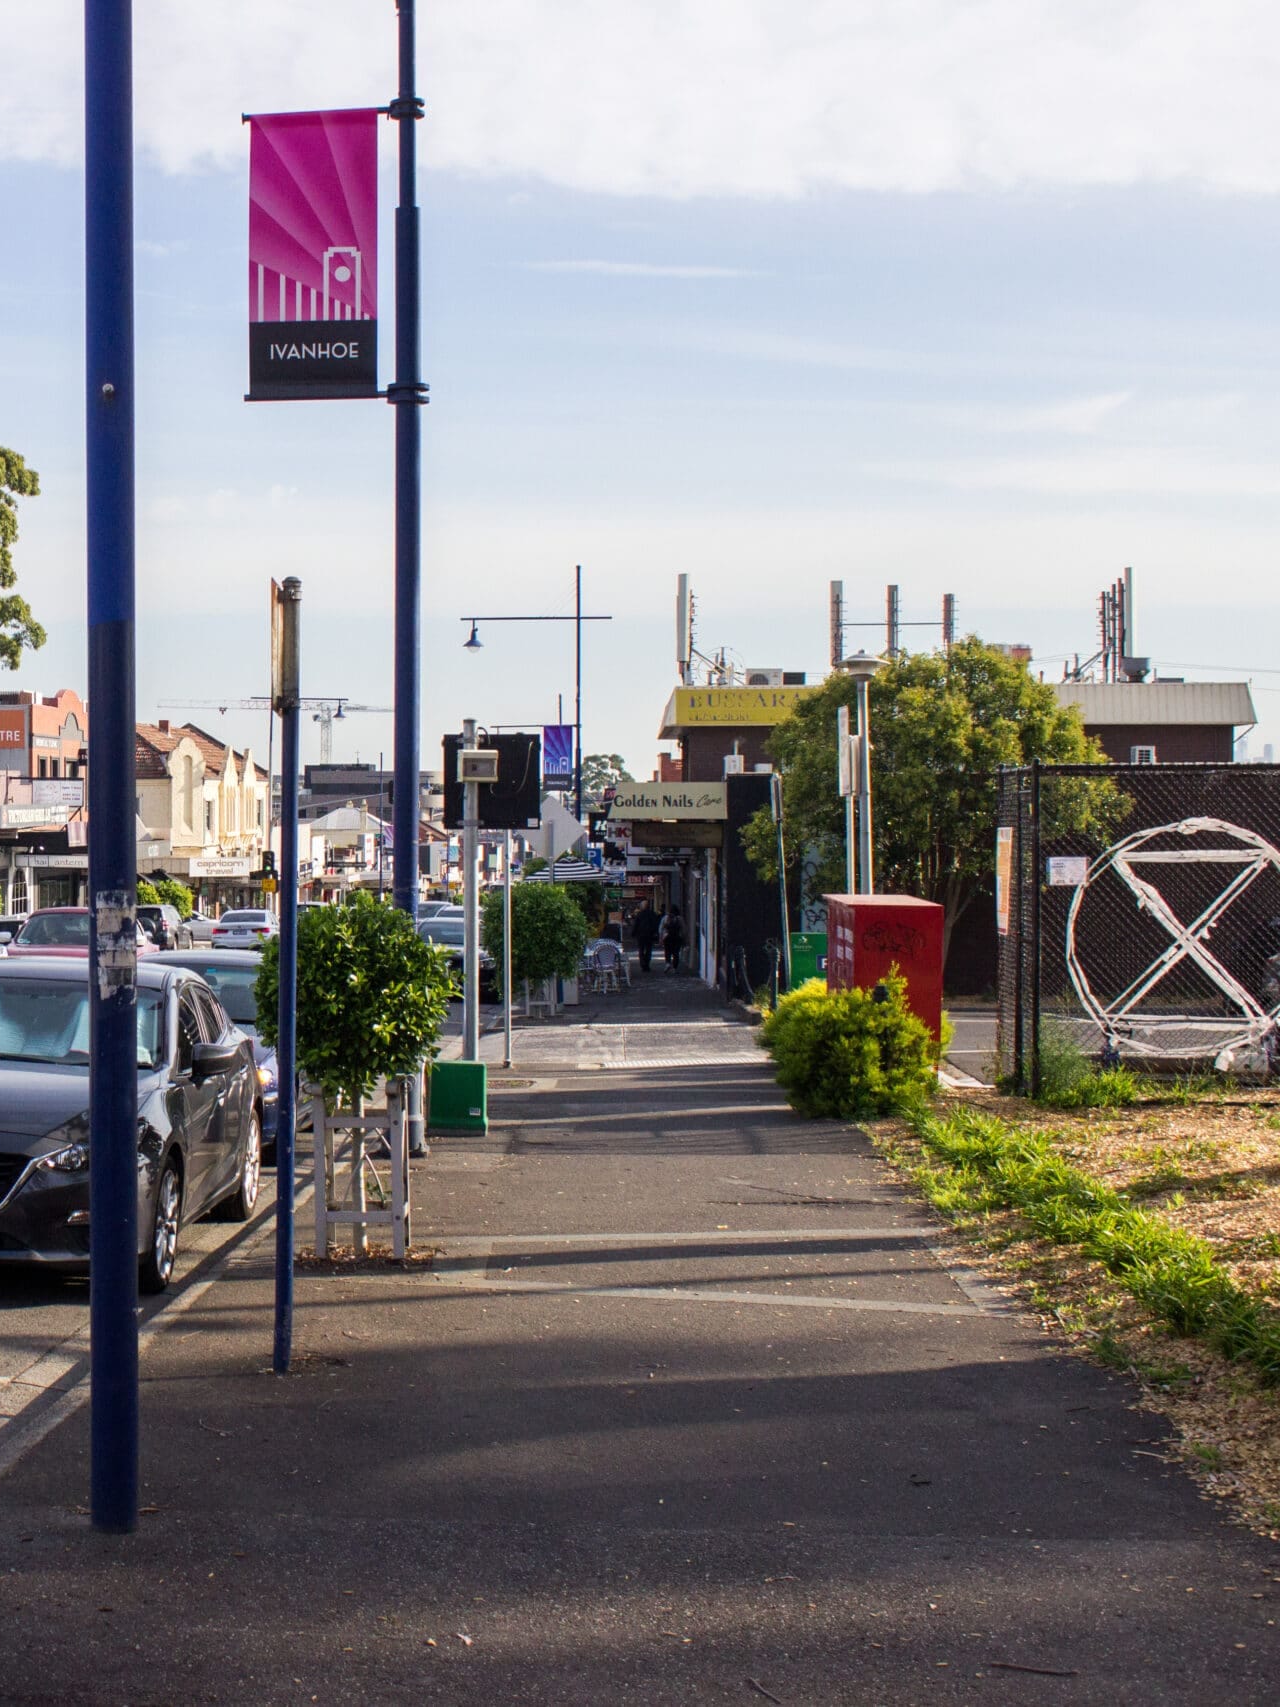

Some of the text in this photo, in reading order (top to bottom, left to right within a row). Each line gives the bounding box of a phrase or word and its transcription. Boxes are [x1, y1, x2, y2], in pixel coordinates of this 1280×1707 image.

[270, 343, 359, 360] IVANHOE
[613, 794, 658, 808] Golden
[662, 794, 694, 808] Nails
[196, 859, 245, 869] capricorn
[205, 867, 235, 875] travel
